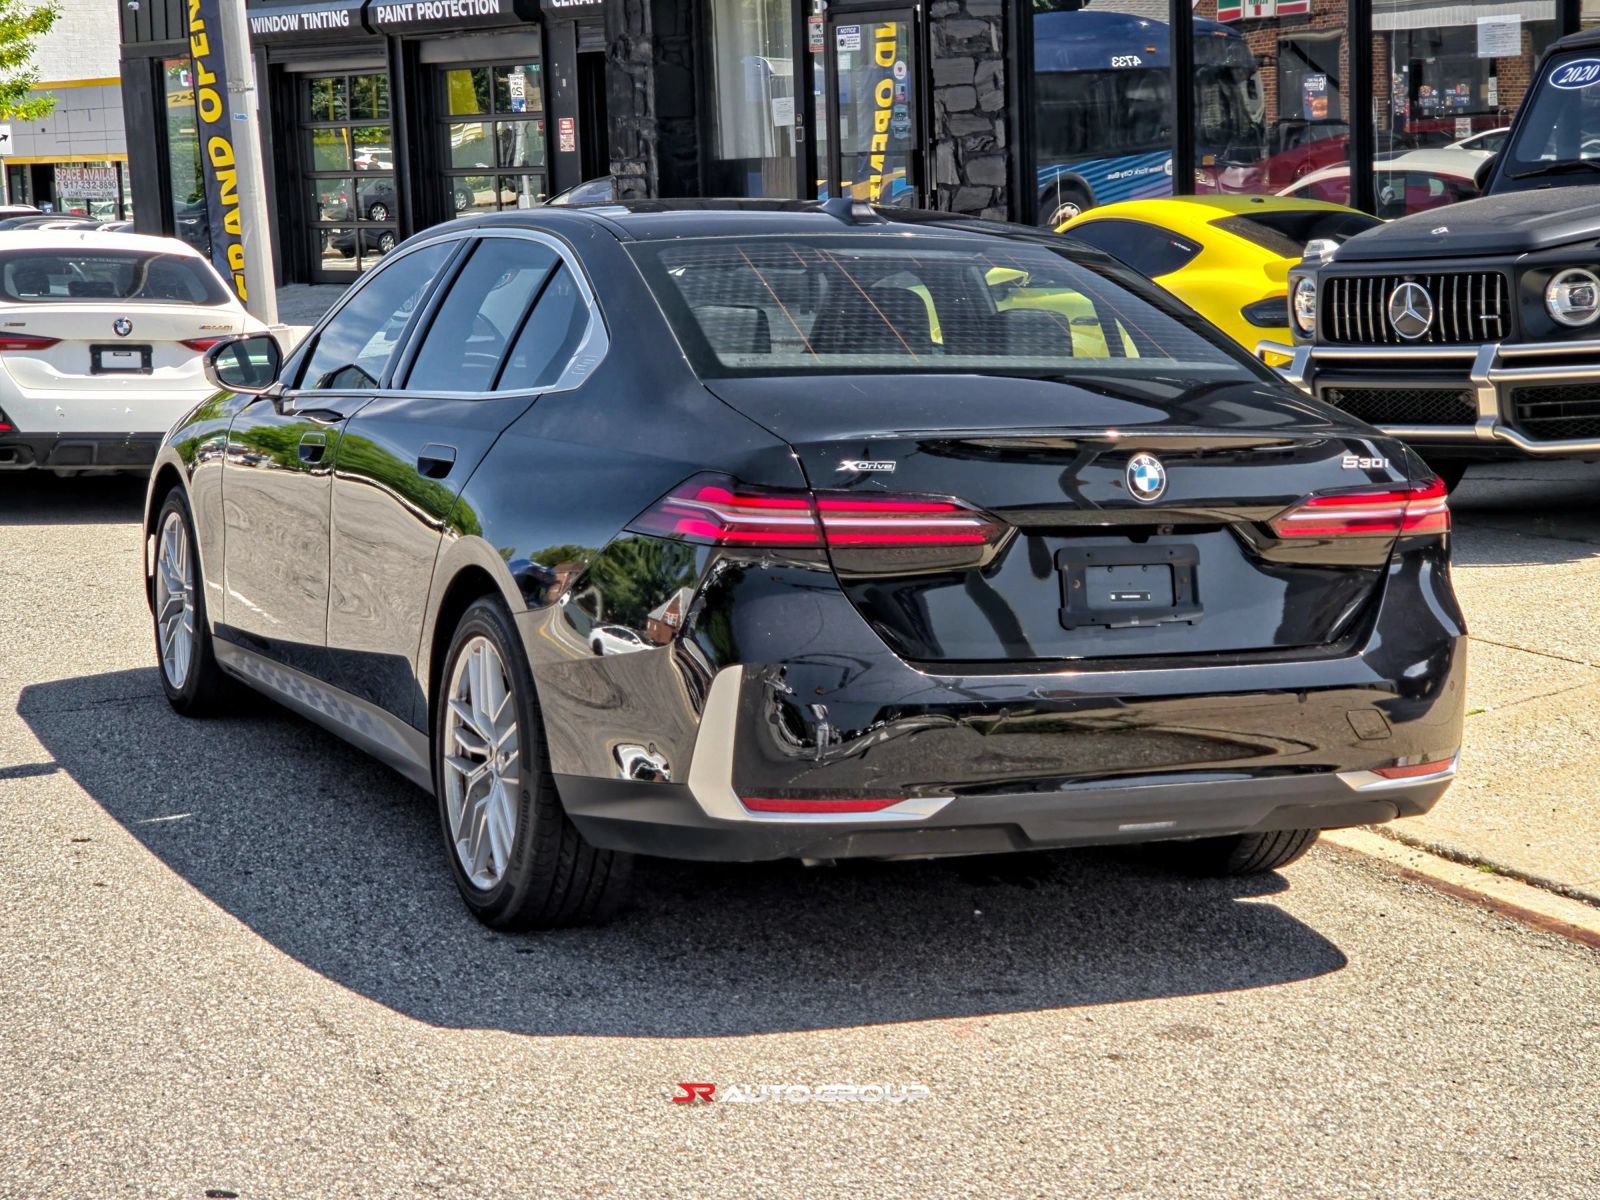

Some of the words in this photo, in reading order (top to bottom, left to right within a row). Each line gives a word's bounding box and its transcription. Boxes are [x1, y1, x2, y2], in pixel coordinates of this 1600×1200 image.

[251, 14, 299, 34] WINDOW
[301, 10, 350, 30] TINTING
[377, 4, 414, 24] PAINT
[417, 0, 501, 21] PROTECTION
[1558, 64, 1600, 84] 2020
[55, 168, 82, 180] SPACE
